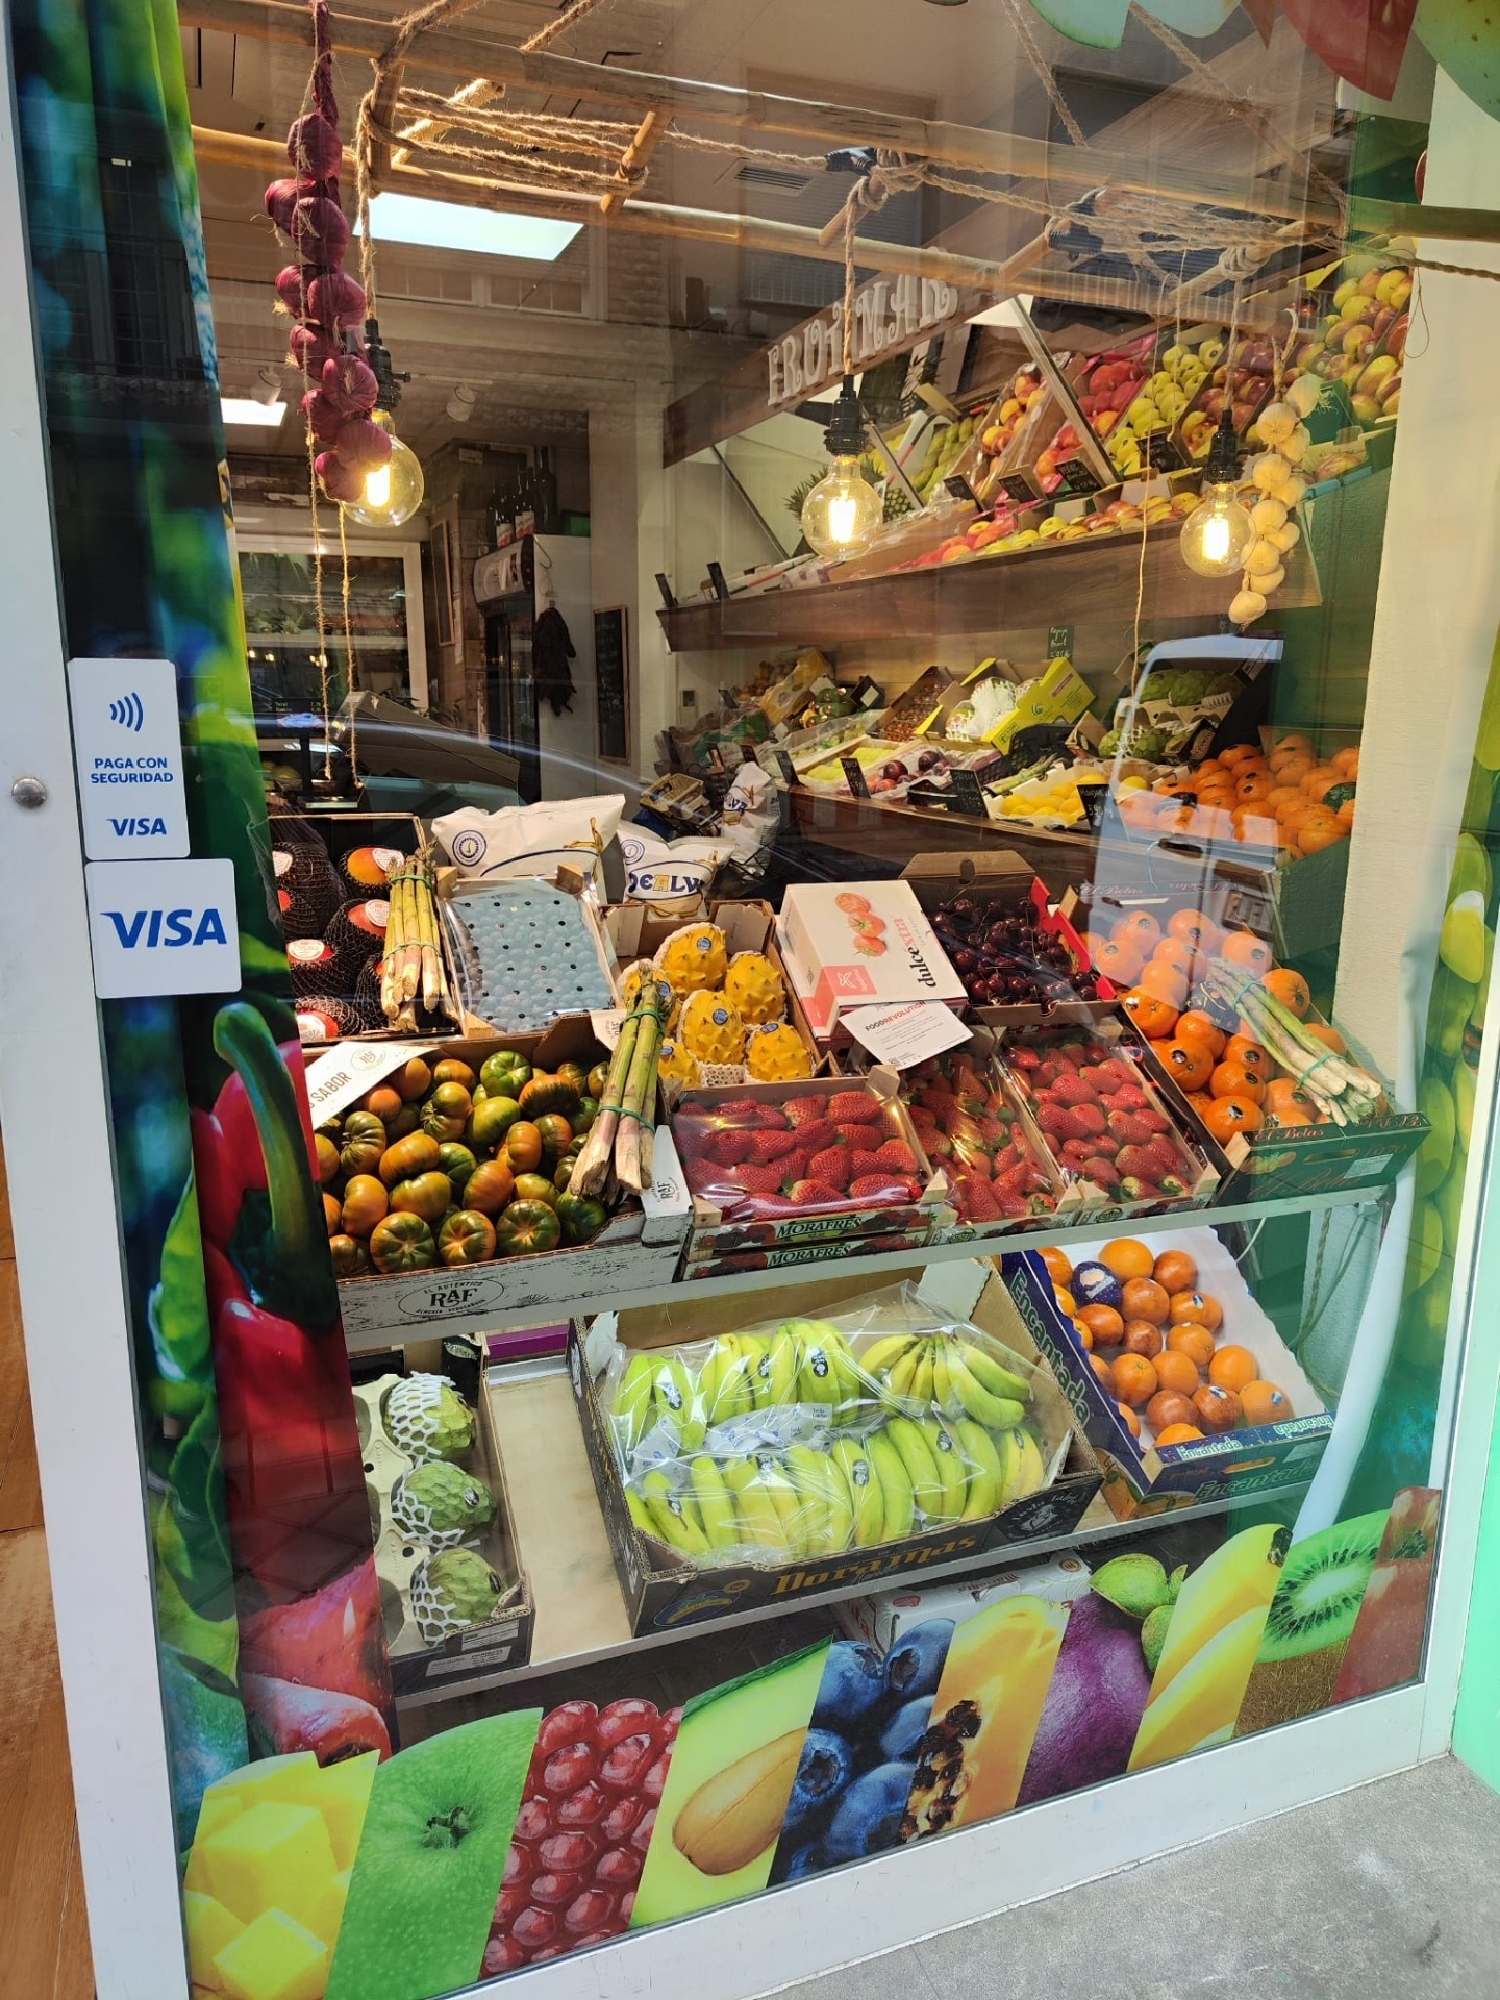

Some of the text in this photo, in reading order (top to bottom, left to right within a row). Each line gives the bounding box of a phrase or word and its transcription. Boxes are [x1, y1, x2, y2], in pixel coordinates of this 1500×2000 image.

[94, 757, 168, 769] PAGA CON
[90, 772, 174, 784] SEGURIDAD
[106, 818, 168, 836] VISA
[100, 908, 227, 949] VISA
[310, 1070, 352, 1103] SABOR
[776, 1217, 861, 1238] MORAFRES
[767, 1245, 851, 1268] MORAFRES
[429, 1287, 478, 1308] RAF
[1010, 1269, 1091, 1428] Encantada
[1273, 1414, 1335, 1438] Encantada
[1176, 1435, 1244, 1461] Encantada
[1195, 1457, 1314, 1503] Encantad
